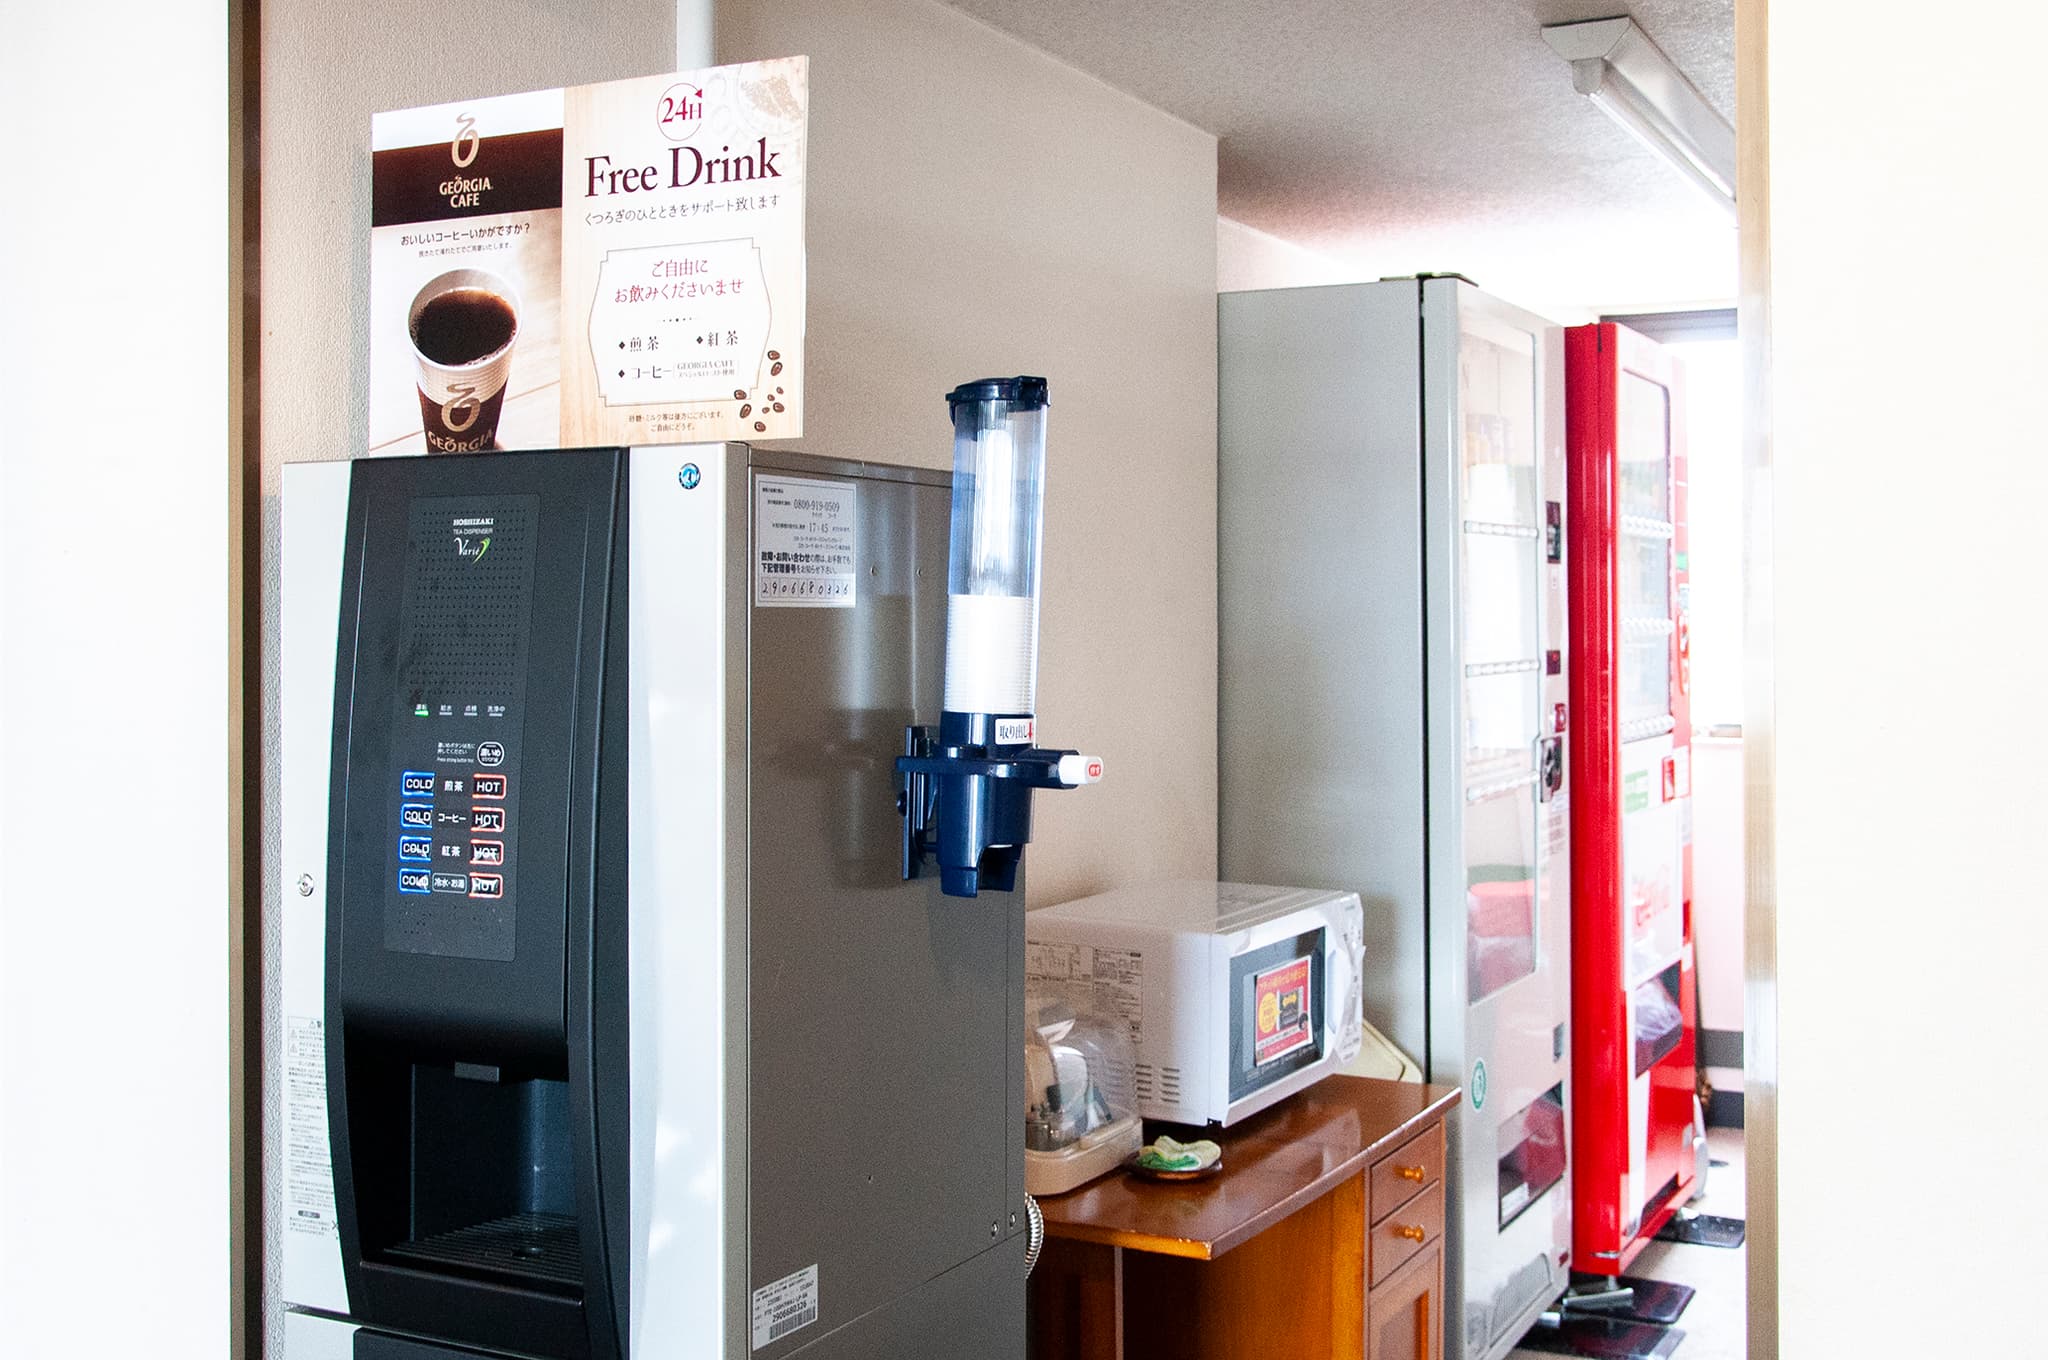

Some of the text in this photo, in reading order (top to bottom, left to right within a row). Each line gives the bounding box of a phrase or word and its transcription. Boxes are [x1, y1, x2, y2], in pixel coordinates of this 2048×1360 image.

[662, 96, 702, 123] 24H
[584, 136, 782, 198] Free Drink
[450, 192, 480, 208] CAFE
[584, 194, 781, 227] くつろぎのひとときをサポート致します
[400, 222, 531, 247] おいしいコーヒーいかがですか？
[652, 258, 709, 278] ご自由に
[614, 278, 745, 303] お飲みくださいませ
[631, 366, 673, 379] コーヒー
[453, 518, 494, 526] HOSHIZAKI
[406, 778, 501, 793] COLD 煎茶 HOT
[404, 810, 500, 826] COLD コーヒー HOT
[441, 846, 461, 857] 紅茶
